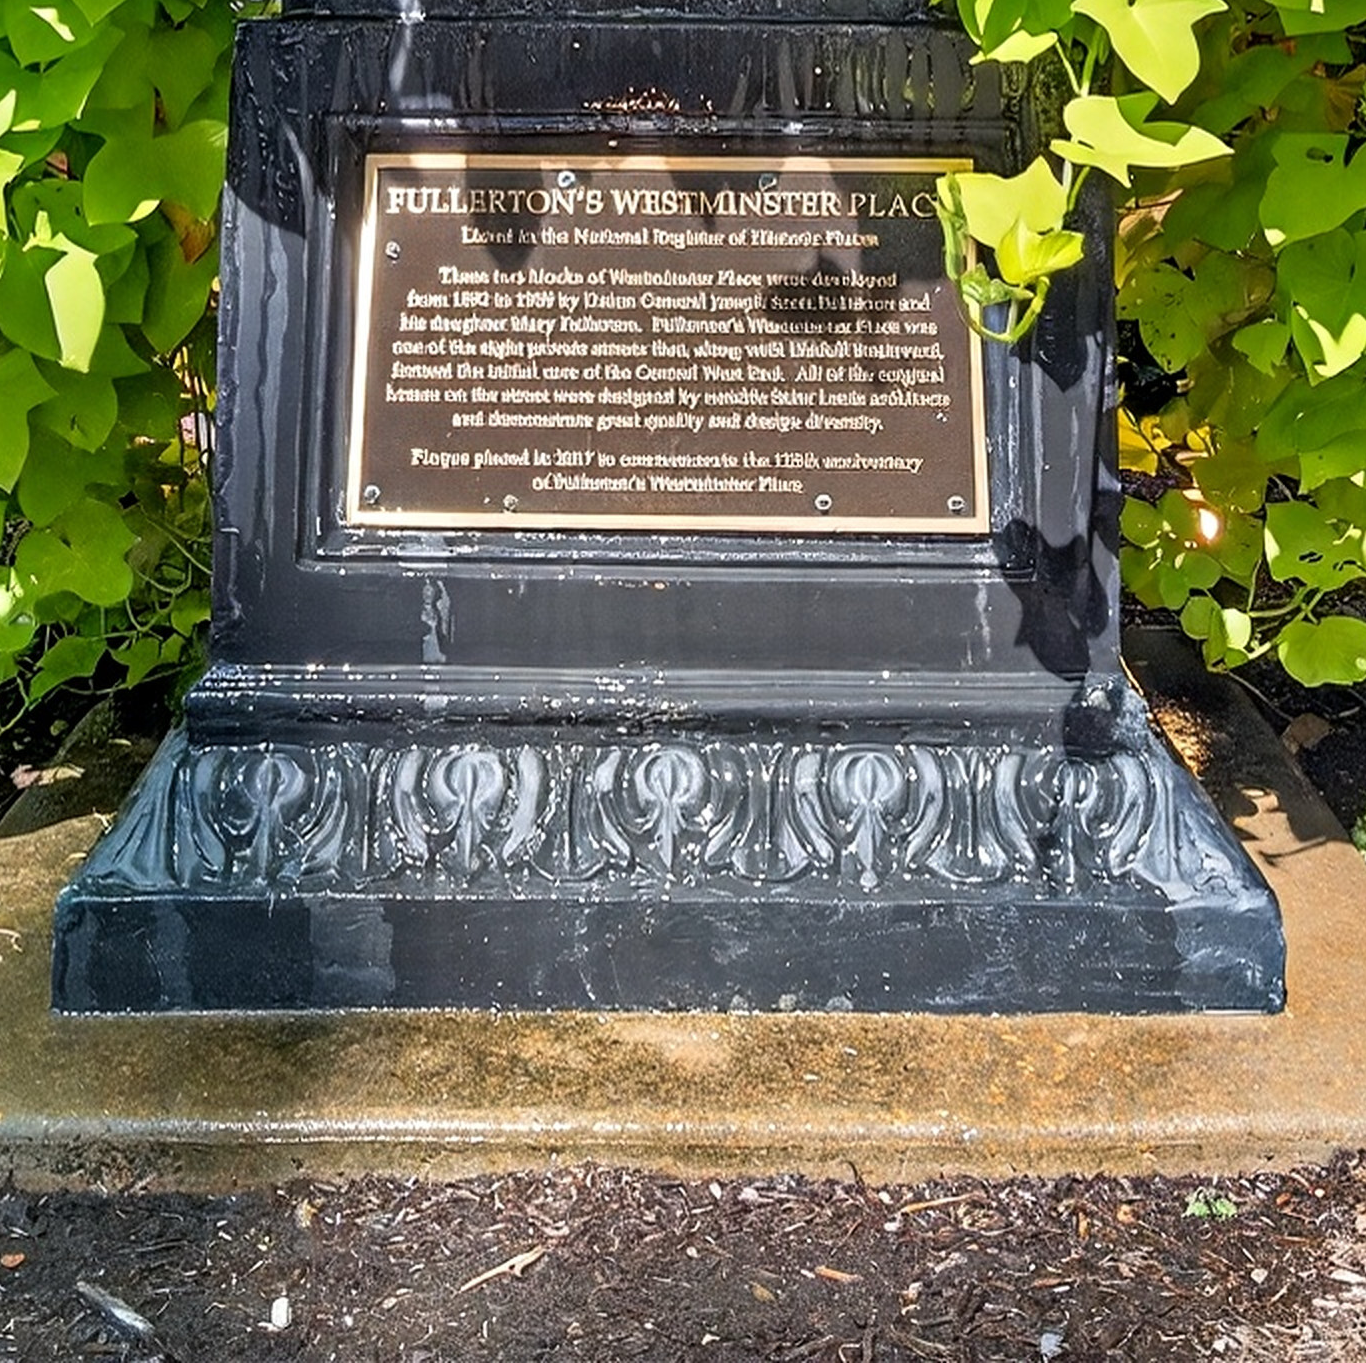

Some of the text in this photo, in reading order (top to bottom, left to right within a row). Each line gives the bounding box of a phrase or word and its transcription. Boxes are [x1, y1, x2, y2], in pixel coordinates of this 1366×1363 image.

[385, 186, 937, 218] FULLERTON'S WESTMINSTER PLAC
[541, 225, 569, 246] the
[729, 228, 747, 246] of
[587, 268, 606, 286] of
[558, 290, 580, 314] by
[898, 292, 932, 312] and
[427, 337, 446, 355] of
[583, 363, 600, 381] of
[794, 364, 822, 383] All
[826, 366, 846, 383] of
[678, 387, 701, 409] by
[410, 448, 471, 469] Plaque
